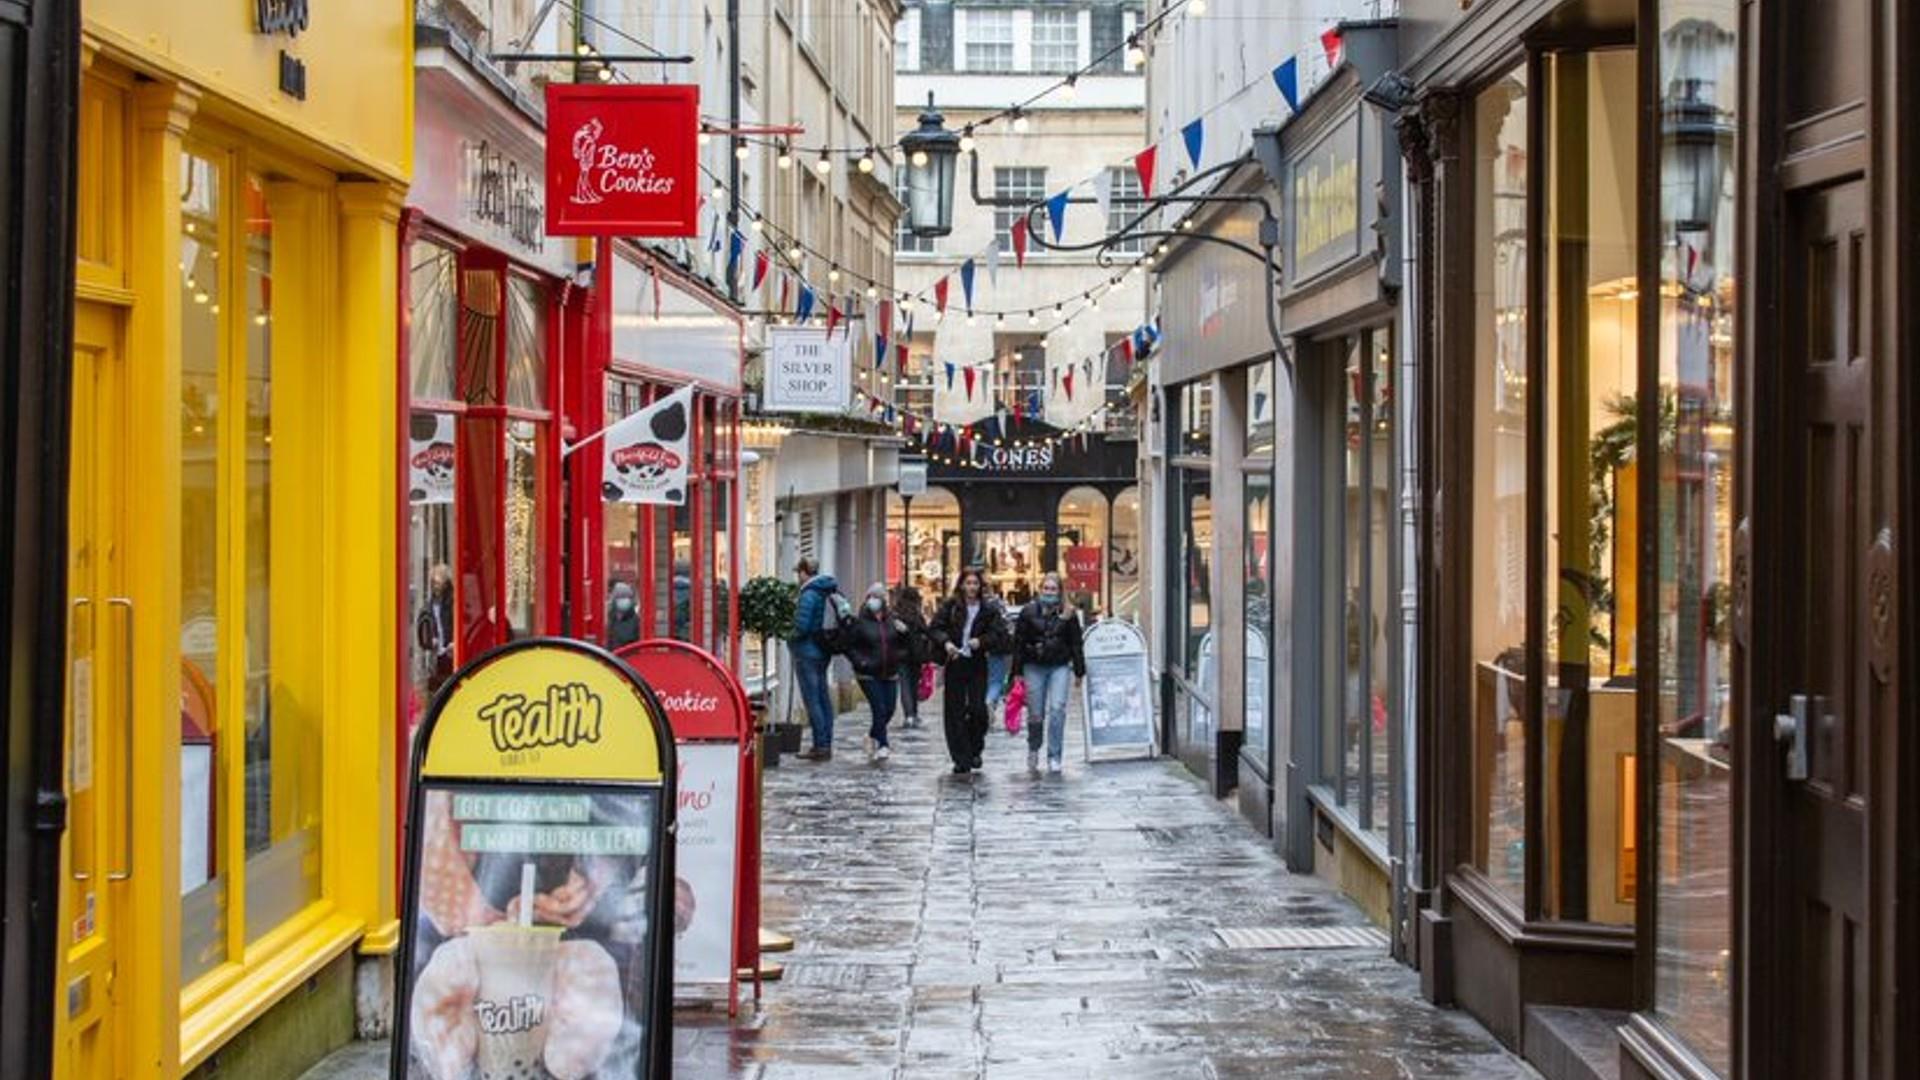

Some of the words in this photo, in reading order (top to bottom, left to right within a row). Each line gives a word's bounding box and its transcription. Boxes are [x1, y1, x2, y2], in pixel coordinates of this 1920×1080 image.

[597, 144, 656, 170] Ben's
[600, 168, 675, 194] Cookies
[795, 344, 822, 357] THE
[782, 362, 833, 375] SILVER
[788, 379, 828, 392] SHOP
[535, 829, 599, 850] BUBBLE
